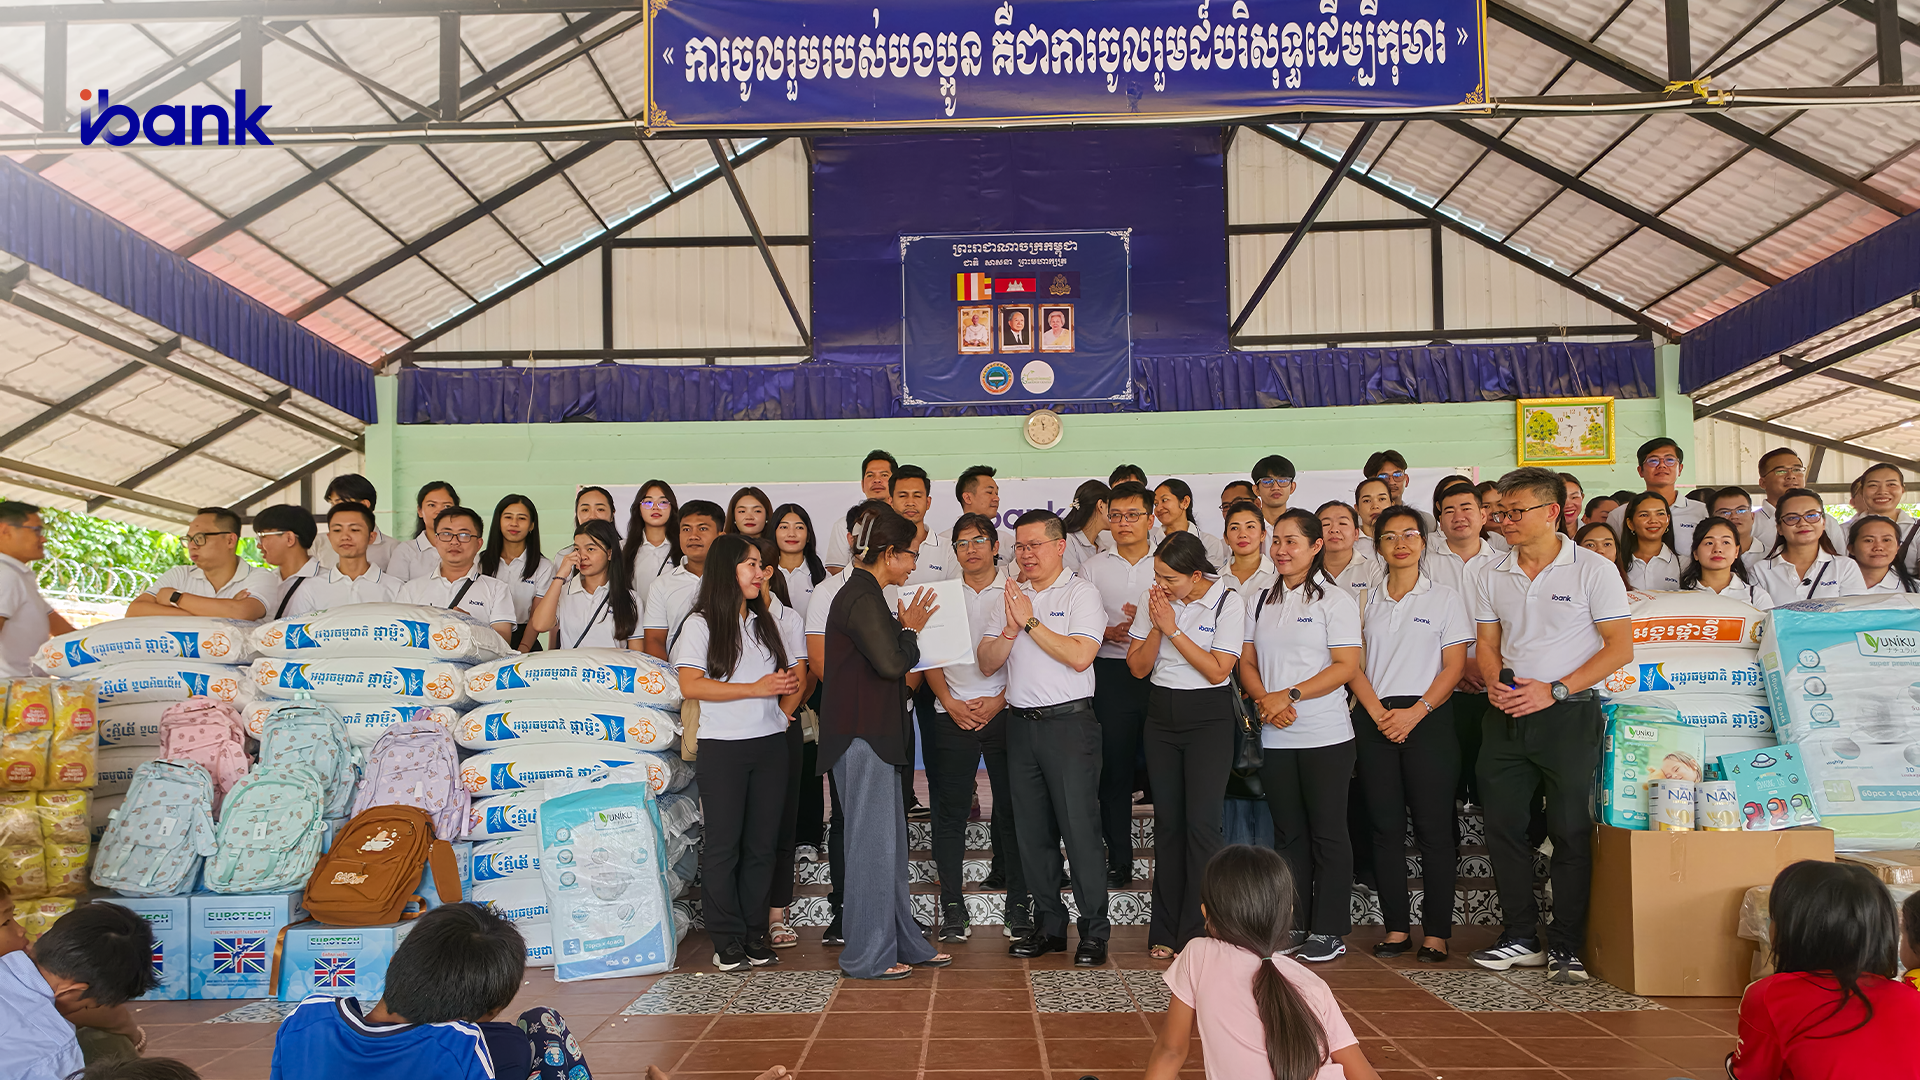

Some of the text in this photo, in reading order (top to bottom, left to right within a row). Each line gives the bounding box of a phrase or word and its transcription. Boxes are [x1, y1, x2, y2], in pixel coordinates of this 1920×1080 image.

[1705, 791, 1737, 803] NAN
[208, 911, 271, 920] EUROTECH
[310, 937, 360, 945] EUROTECH
